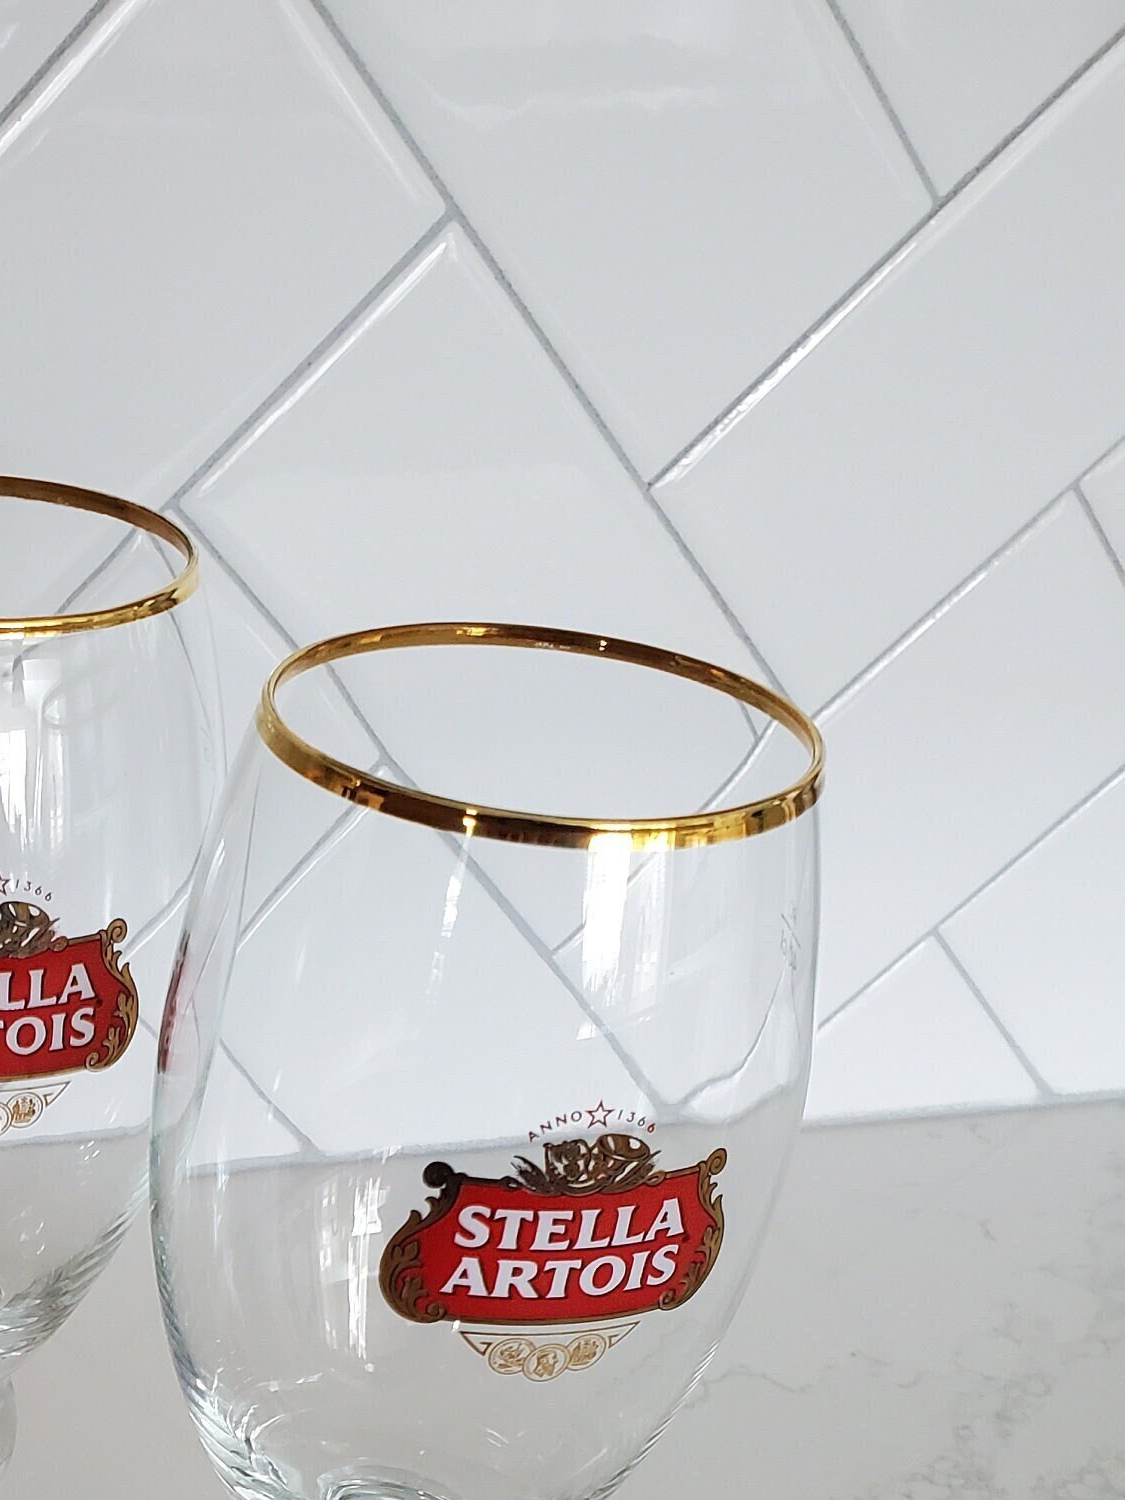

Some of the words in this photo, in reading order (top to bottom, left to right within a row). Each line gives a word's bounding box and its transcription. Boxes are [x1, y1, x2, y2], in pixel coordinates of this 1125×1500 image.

[15, 879, 52, 902] 1366
[528, 1110, 582, 1142] ANNO
[617, 1109, 656, 1133] 1366
[454, 1198, 685, 1251] STELLA
[440, 1245, 679, 1298] ARTOIS
